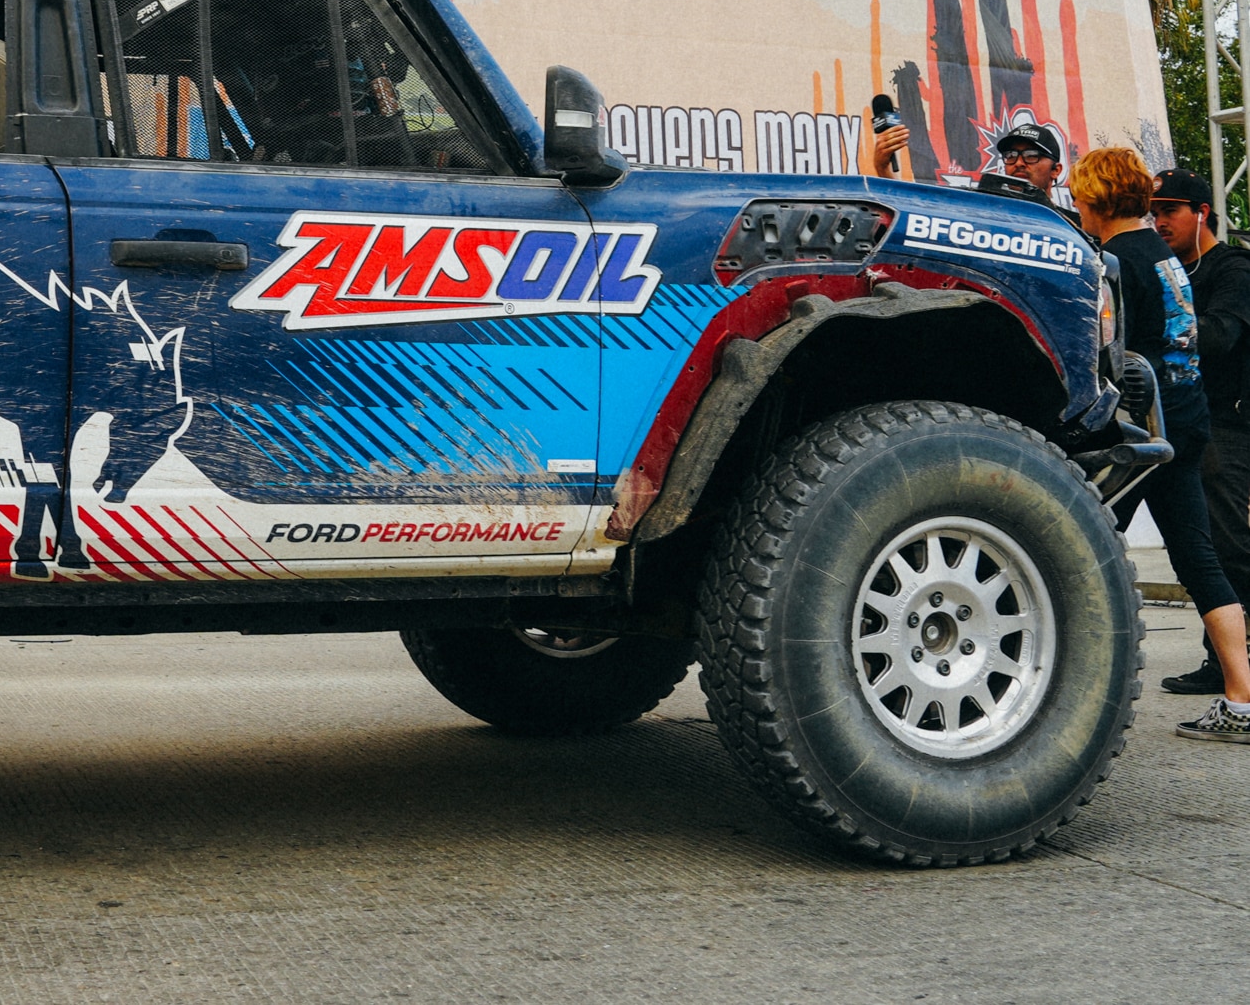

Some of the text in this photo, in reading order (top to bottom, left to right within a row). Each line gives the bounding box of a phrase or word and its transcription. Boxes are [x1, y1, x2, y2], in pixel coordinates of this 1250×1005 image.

[604, 103, 744, 173] eyers
[257, 220, 651, 318] AMSOIL
[905, 213, 1083, 265] BFGoodrich
[265, 521, 566, 543] FORD PERFORMANCE
